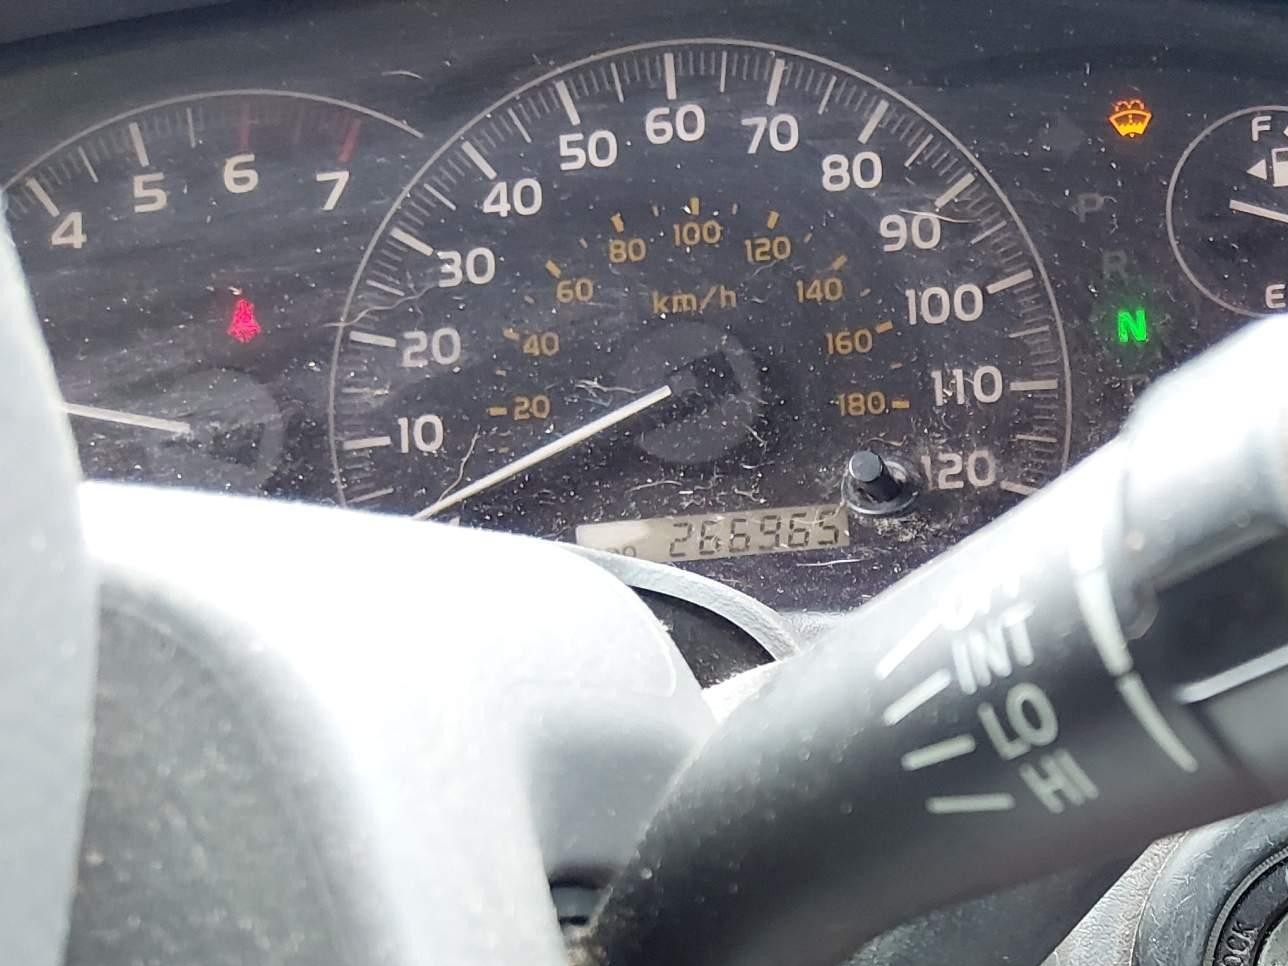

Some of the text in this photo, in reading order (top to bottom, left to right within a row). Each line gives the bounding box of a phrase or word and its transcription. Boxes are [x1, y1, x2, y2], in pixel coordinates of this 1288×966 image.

[645, 104, 705, 144] 60
[741, 113, 799, 154] 70
[1251, 115, 1272, 142] F
[559, 130, 618, 170] 50
[223, 154, 258, 194] 6
[316, 170, 350, 210] 7
[822, 151, 882, 192] 80
[133, 173, 167, 213] 5
[483, 178, 542, 217] 40
[51, 212, 87, 249] 4
[673, 220, 722, 247] 100
[744, 236, 791, 263] 120
[880, 213, 941, 251] 90
[437, 247, 496, 287] 30
[609, 238, 647, 263] 80
[556, 278, 594, 303] 60
[653, 285, 737, 314] km/h
[796, 277, 843, 303] 140
[905, 284, 984, 325] 100
[1265, 283, 1286, 309] E
[523, 332, 560, 356] 40
[825, 329, 873, 355] 160
[1117, 310, 1148, 343] N
[403, 328, 462, 367] 20
[837, 392, 886, 416] 180
[931, 366, 1002, 406] 110
[513, 396, 550, 420] 20
[398, 414, 444, 453] 10
[920, 450, 996, 490] 120
[669, 508, 840, 558] 266965
[951, 602, 1036, 695] INT
[977, 682, 1058, 760] LO
[1020, 747, 1099, 814] HI
